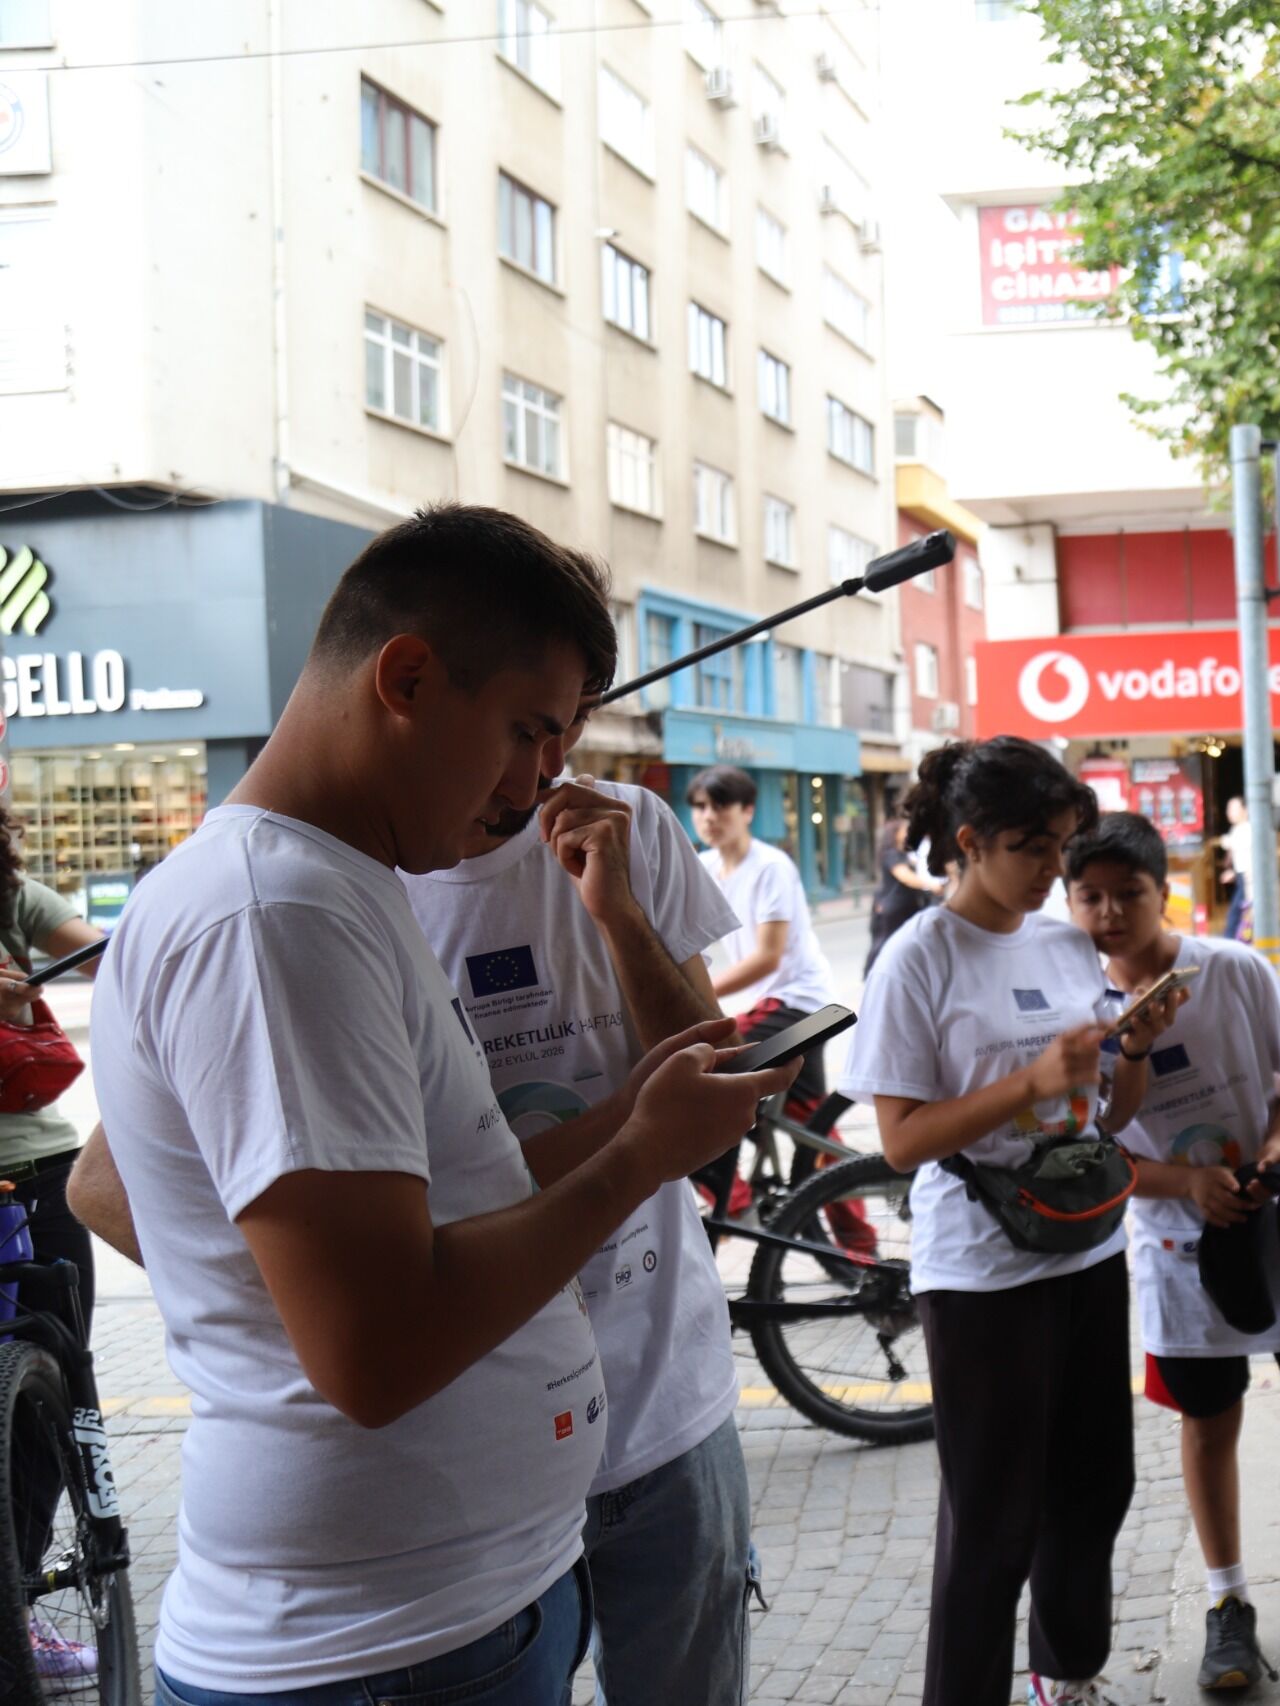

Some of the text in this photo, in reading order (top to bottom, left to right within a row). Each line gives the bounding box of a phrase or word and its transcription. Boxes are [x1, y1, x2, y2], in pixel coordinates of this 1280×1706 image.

[483, 1011, 623, 1056] REKETLİLİK HAFTAS
[505, 1051, 539, 1067] EYLÜL
[541, 1047, 565, 1060] 2026
[73, 1407, 101, 1426] 32
